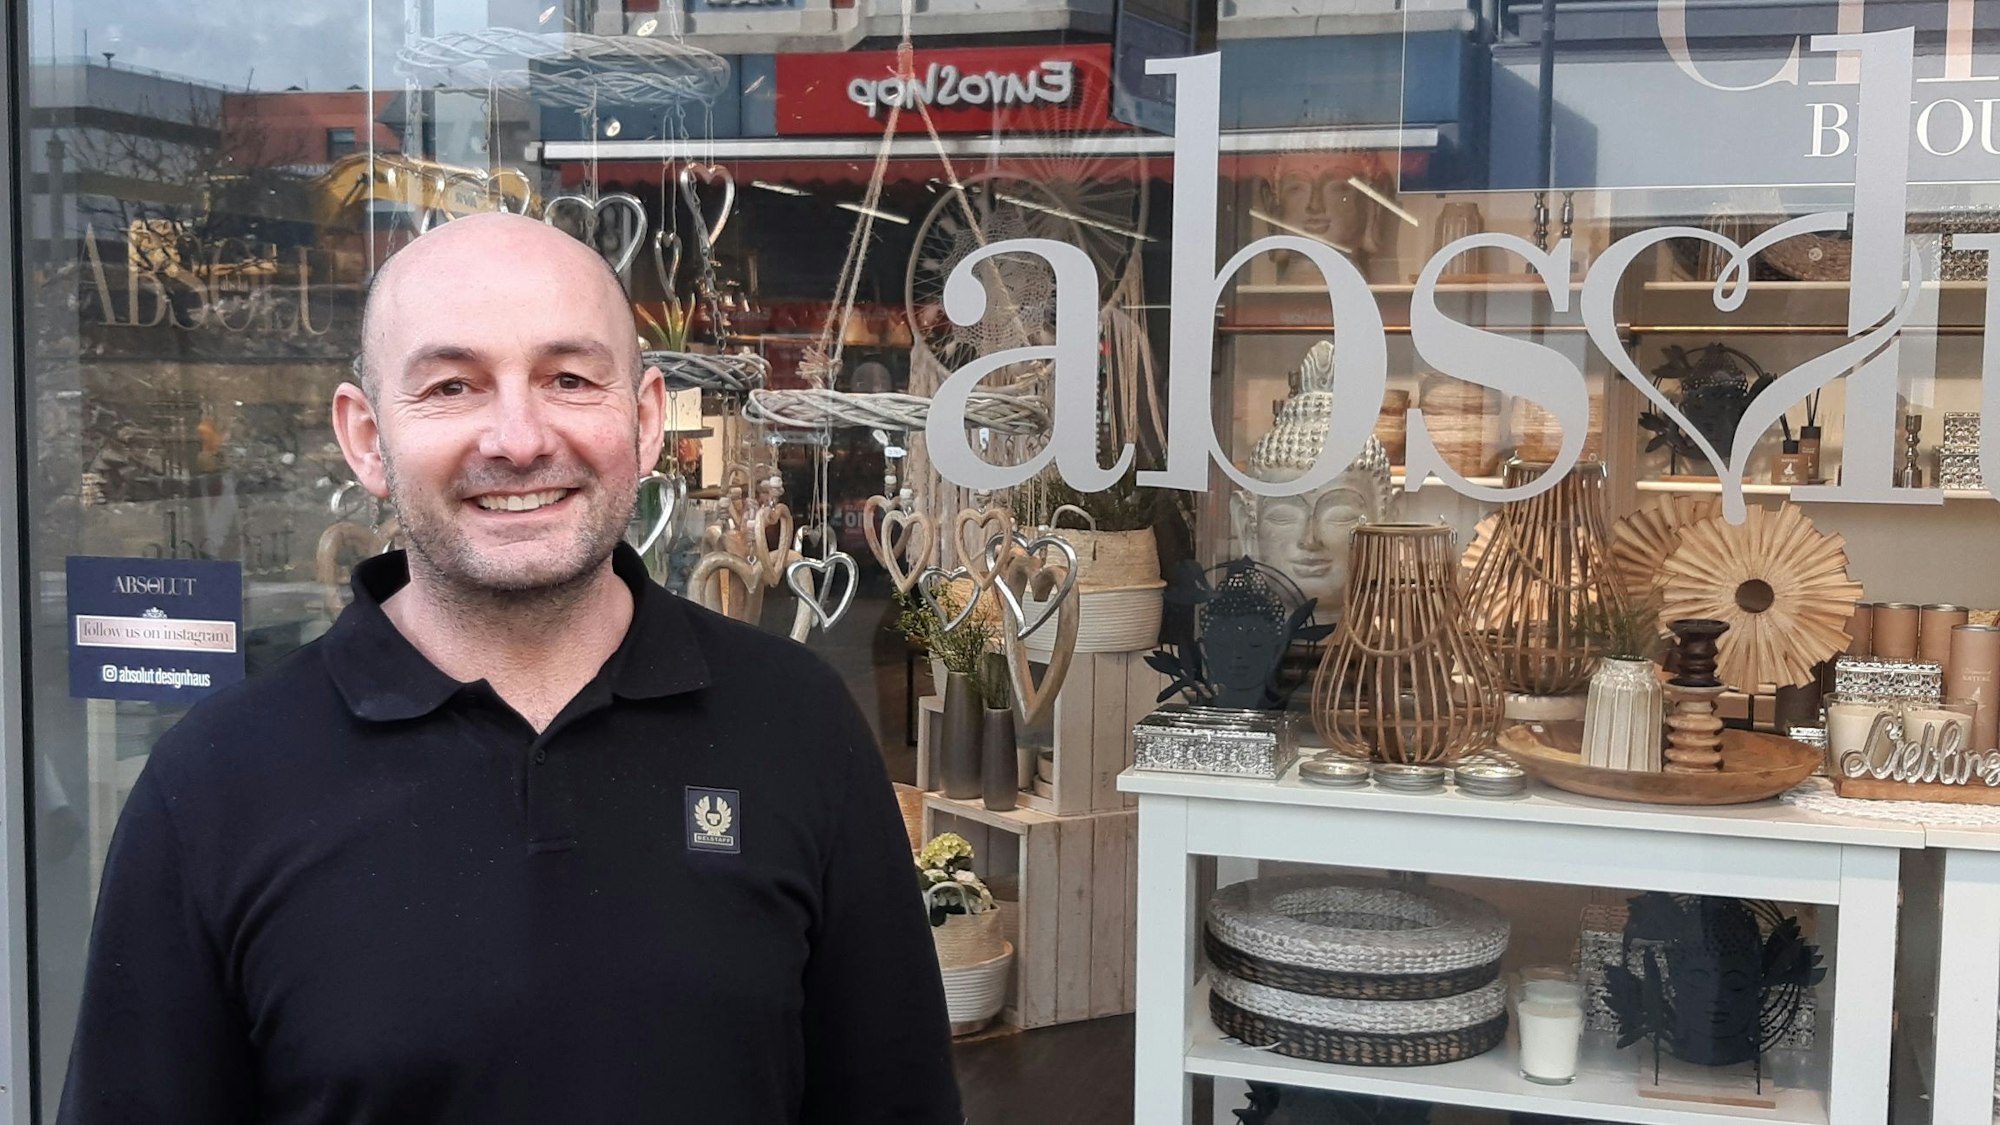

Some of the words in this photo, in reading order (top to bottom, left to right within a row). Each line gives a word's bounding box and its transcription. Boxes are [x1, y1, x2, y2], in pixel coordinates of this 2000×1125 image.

[113, 576, 196, 595] ABSOLUT
[83, 620, 121, 638] follow
[125, 627, 141, 638] us
[144, 628, 160, 639] on
[164, 625, 230, 646] instagram
[697, 835, 731, 843] BELSTAFF
